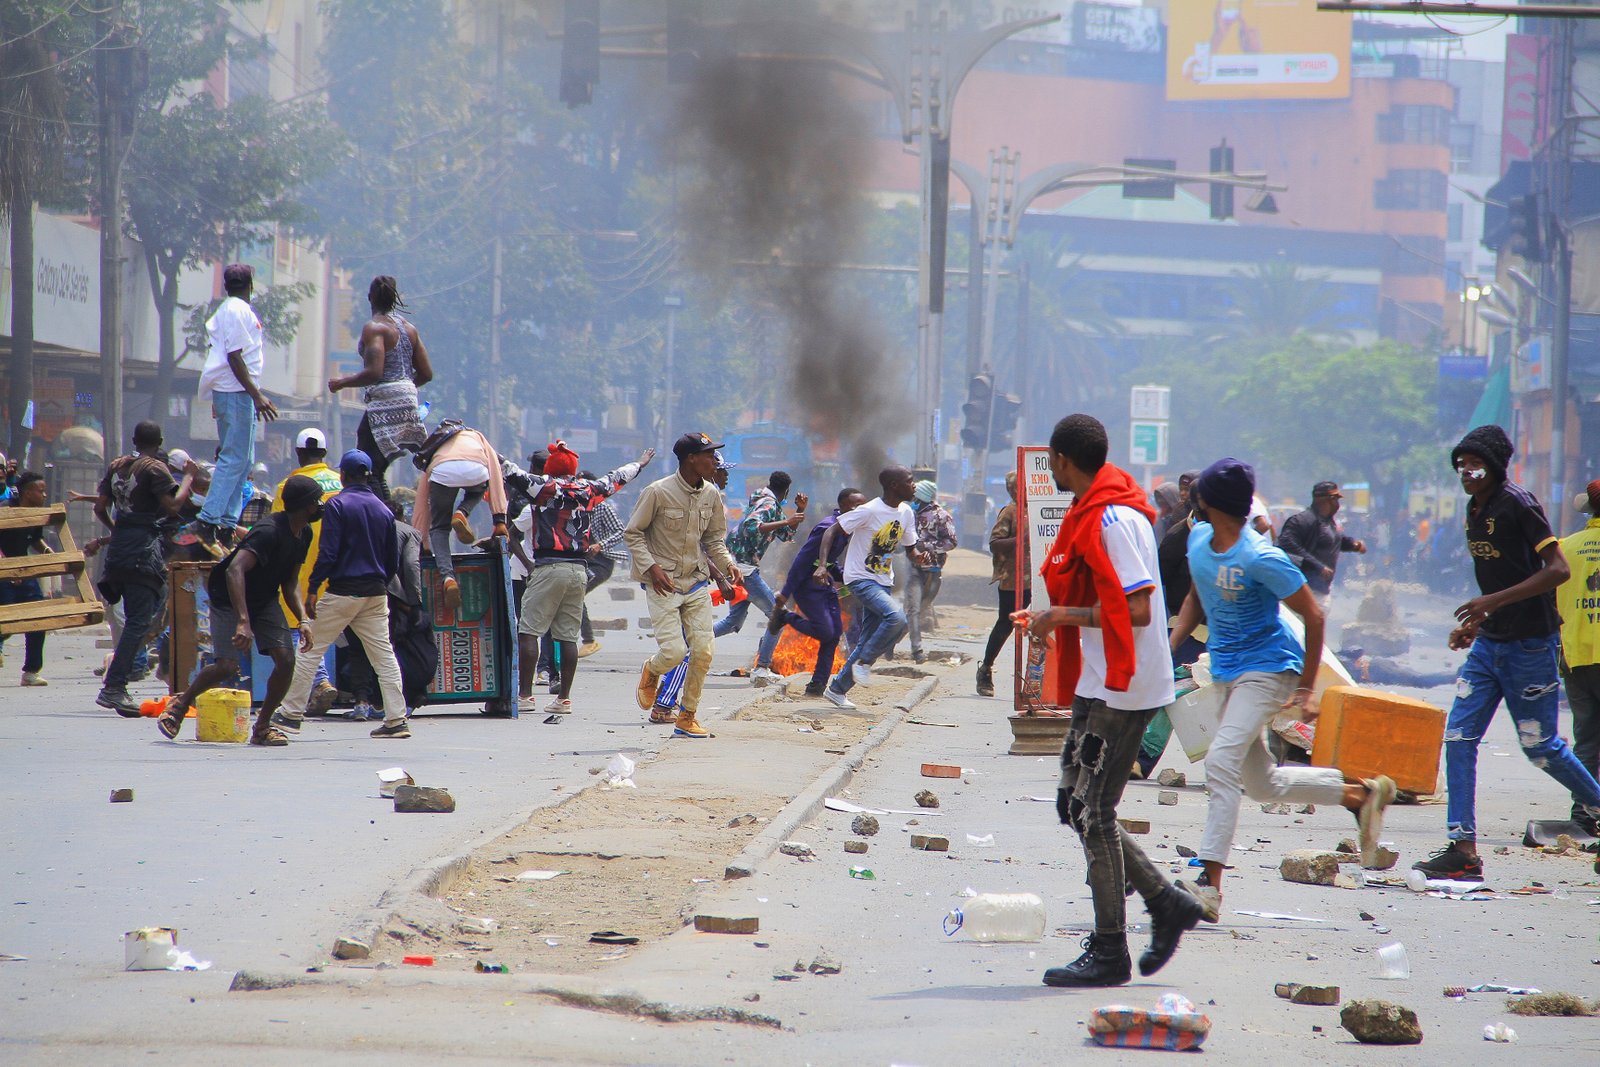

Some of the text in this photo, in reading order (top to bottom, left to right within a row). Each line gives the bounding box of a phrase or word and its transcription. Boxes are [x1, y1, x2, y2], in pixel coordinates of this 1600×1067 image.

[1086, 9, 1112, 23] GET
[1085, 25, 1132, 41] SHAPE
[37, 256, 60, 307] Galaxy
[69, 264, 89, 304] Series
[1031, 474, 1049, 484] KMO
[1028, 485, 1054, 496] SACCO
[1042, 509, 1053, 518] New
[443, 632, 451, 662] AGENT
[453, 631, 471, 692] 2039603
[472, 637, 480, 687] AGENT NO.
